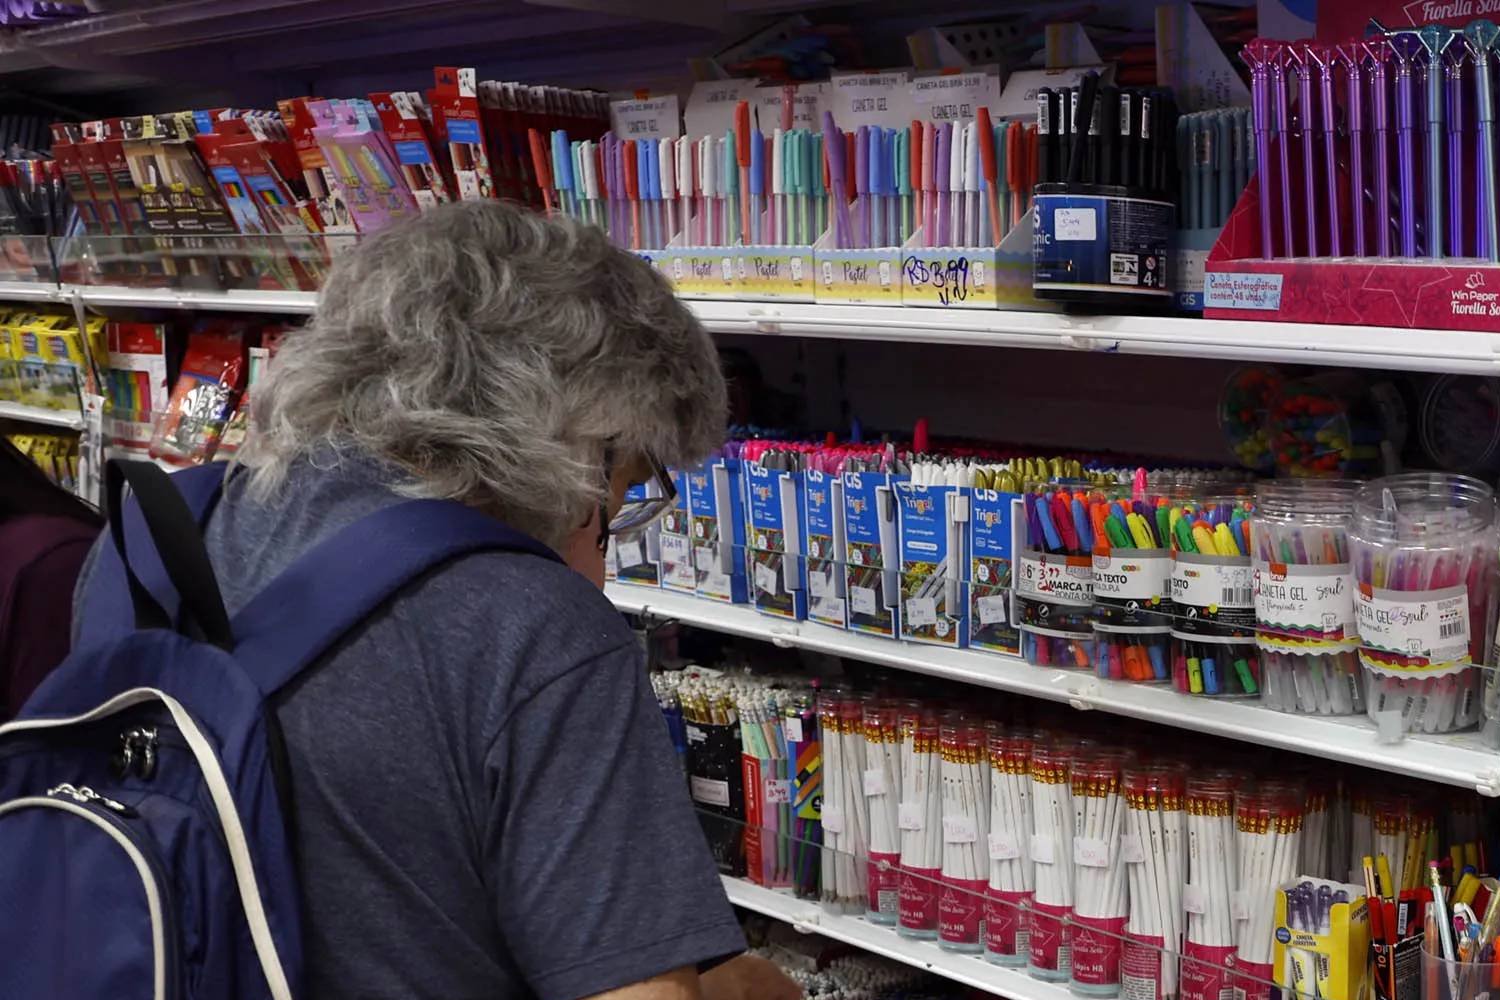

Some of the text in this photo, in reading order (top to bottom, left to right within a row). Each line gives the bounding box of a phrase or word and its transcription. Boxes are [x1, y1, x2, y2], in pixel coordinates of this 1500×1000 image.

[691, 258, 712, 277] Pastel
[755, 257, 779, 277] Pastel
[843, 262, 868, 283] Pastel
[1470, 291, 1499, 303] Paper
[975, 507, 1002, 527] Trigel
[1103, 575, 1128, 584] TEXTO
